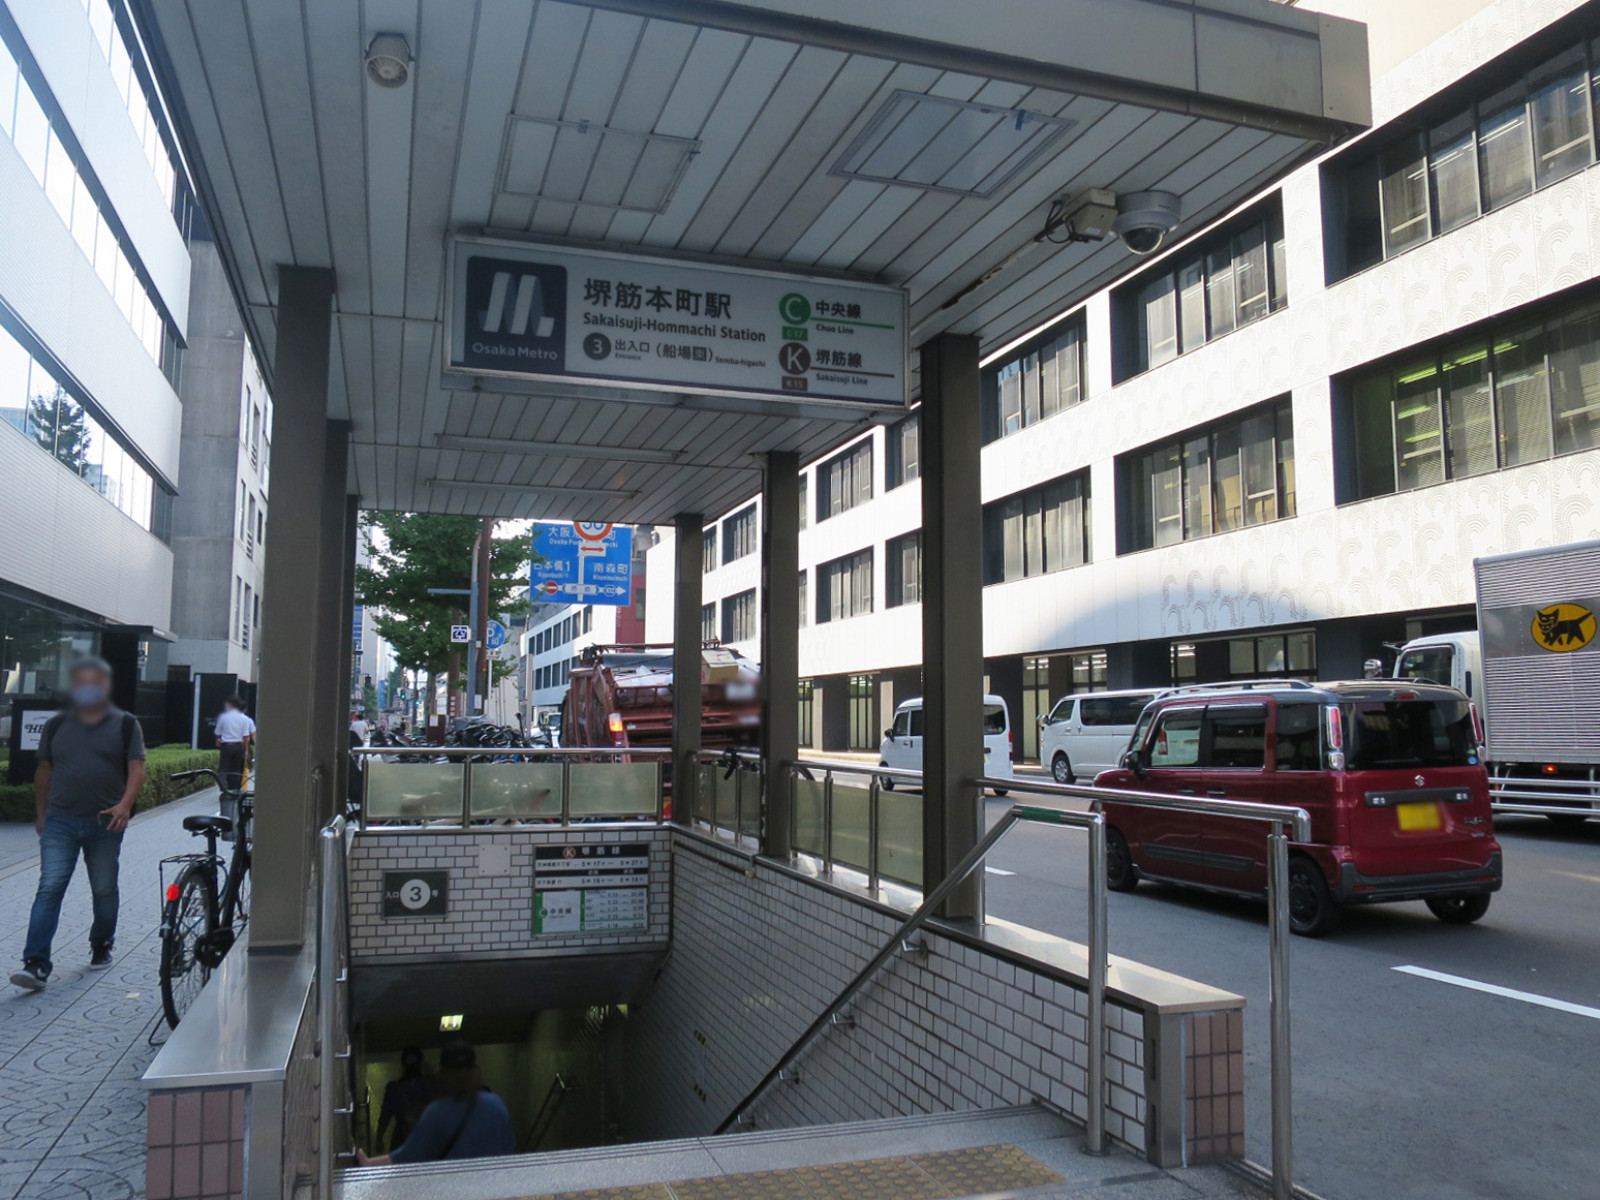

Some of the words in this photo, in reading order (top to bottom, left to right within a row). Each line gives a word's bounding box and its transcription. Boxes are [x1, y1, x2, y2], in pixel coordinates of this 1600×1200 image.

[583, 277, 732, 320] 堺筋本町駅
[785, 297, 803, 320] C
[815, 300, 862, 319] 中央線
[583, 312, 717, 338] Sakaisuji-Hommachi
[720, 326, 767, 342] Station
[816, 323, 836, 333] Chuo
[837, 326, 855, 335] Line
[472, 342, 516, 356] Osaka
[517, 346, 559, 361] Metro
[615, 353, 641, 361] Entrance
[786, 346, 804, 371] K
[815, 348, 862, 368] 堺筋線
[715, 356, 767, 368] Semba-higashi
[816, 373, 851, 385] Sakaisuji
[851, 377, 869, 386] Line
[409, 886, 422, 902] 3
